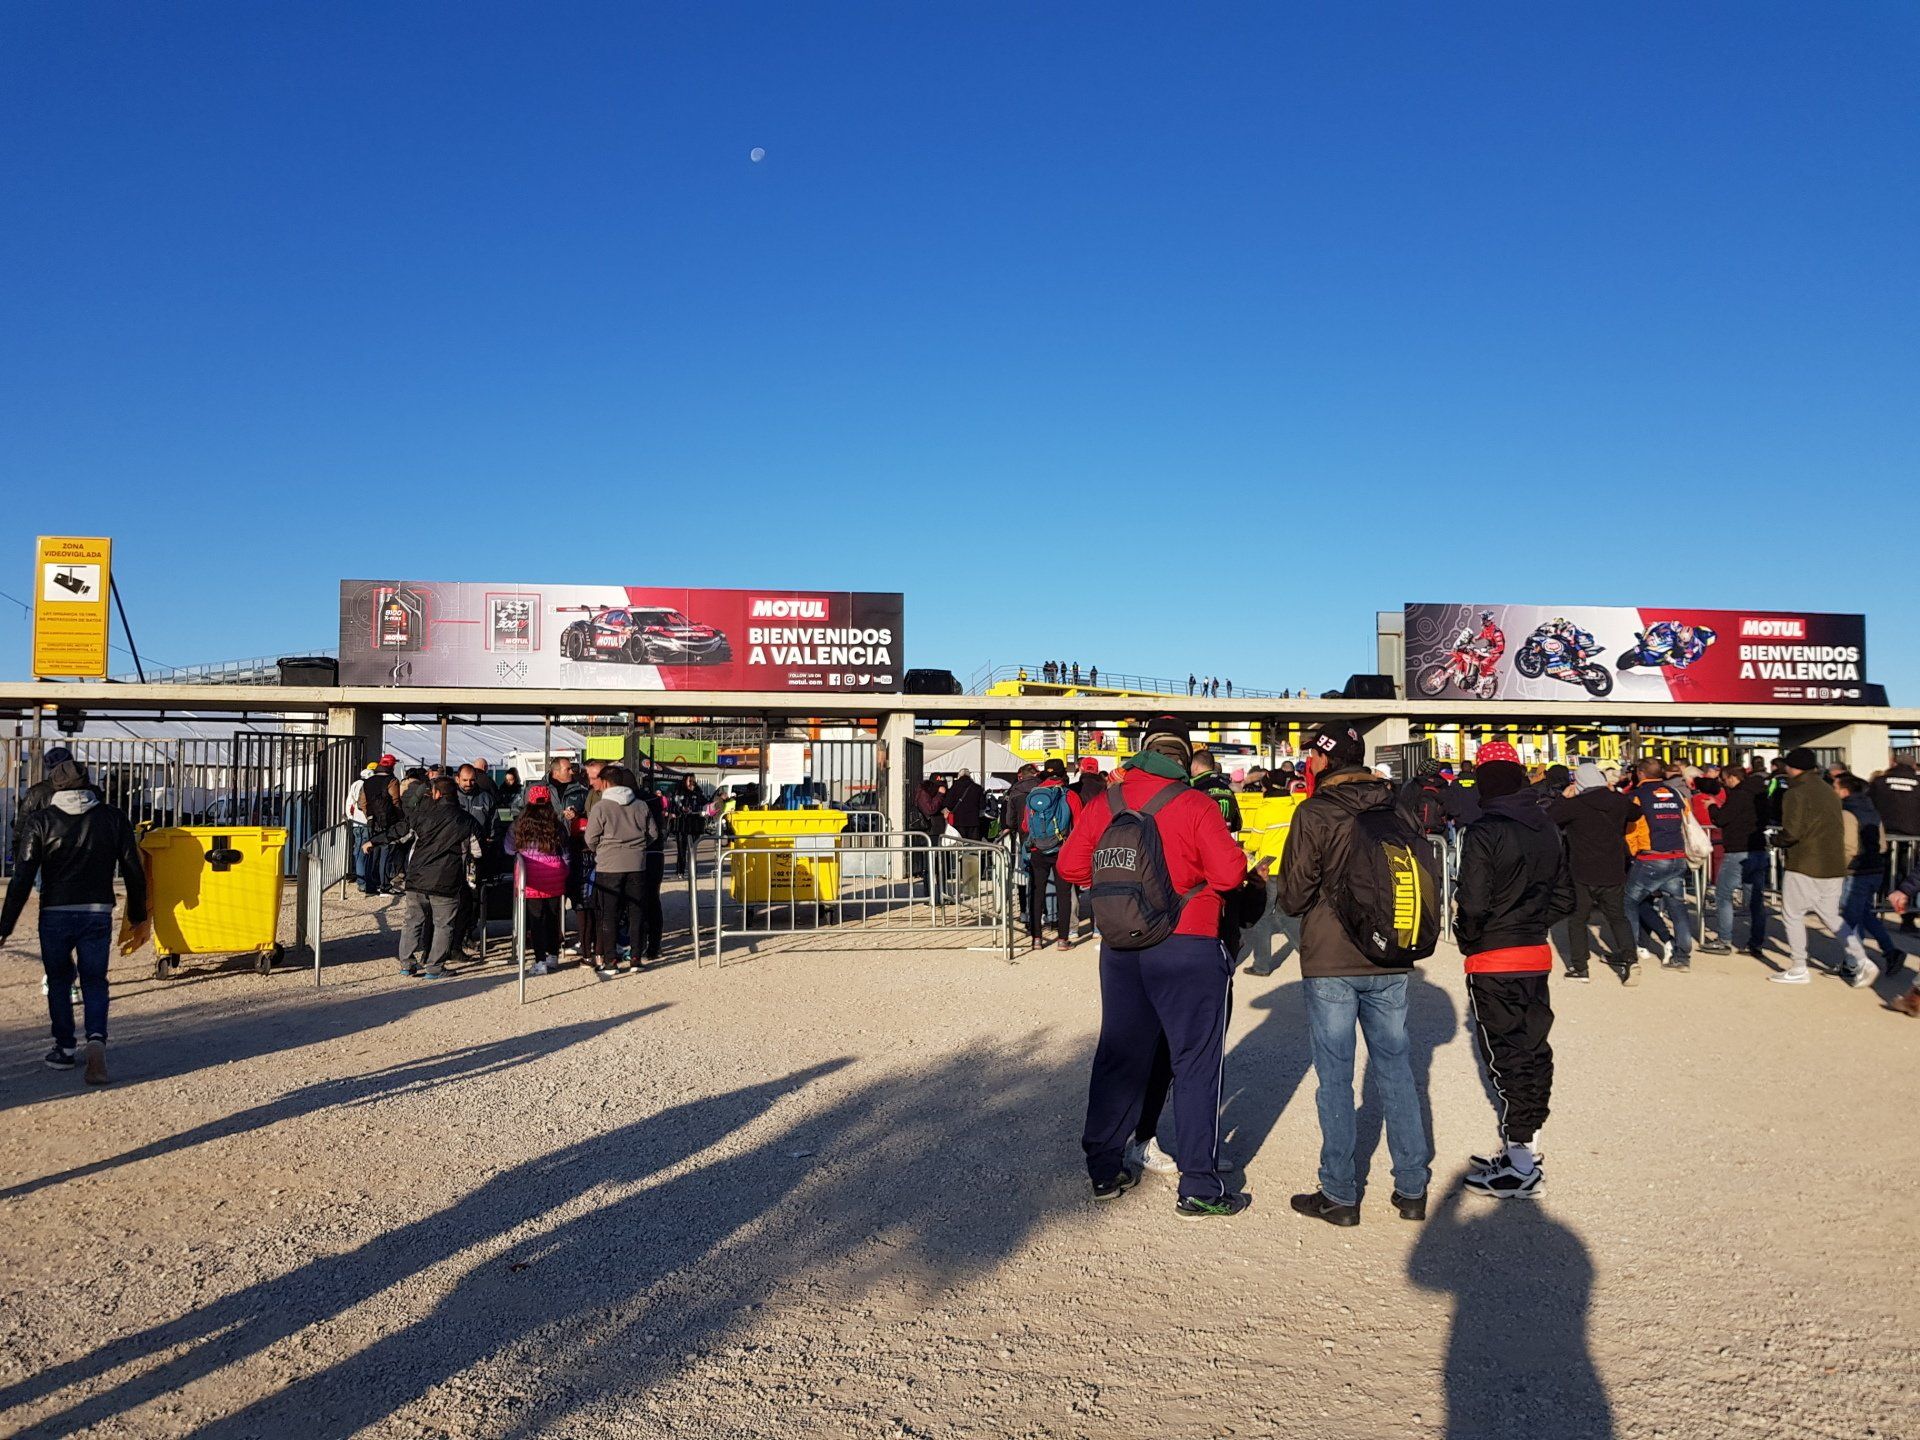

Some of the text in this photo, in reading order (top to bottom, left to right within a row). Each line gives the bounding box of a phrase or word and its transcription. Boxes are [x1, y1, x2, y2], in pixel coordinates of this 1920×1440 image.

[753, 600, 825, 618] MOTUL
[749, 627, 892, 645] BIENVENIDOS
[1742, 620, 1804, 637] MOTUL
[596, 636, 618, 646] MOTUL
[749, 646, 892, 665] A VALENCIA
[1739, 644, 1859, 662] BIENVENIDOS
[1740, 661, 1860, 681] A VALENCIA
[1316, 734, 1337, 752] 93
[1093, 847, 1137, 872] NIKE
[1393, 871, 1414, 930] PUMA
